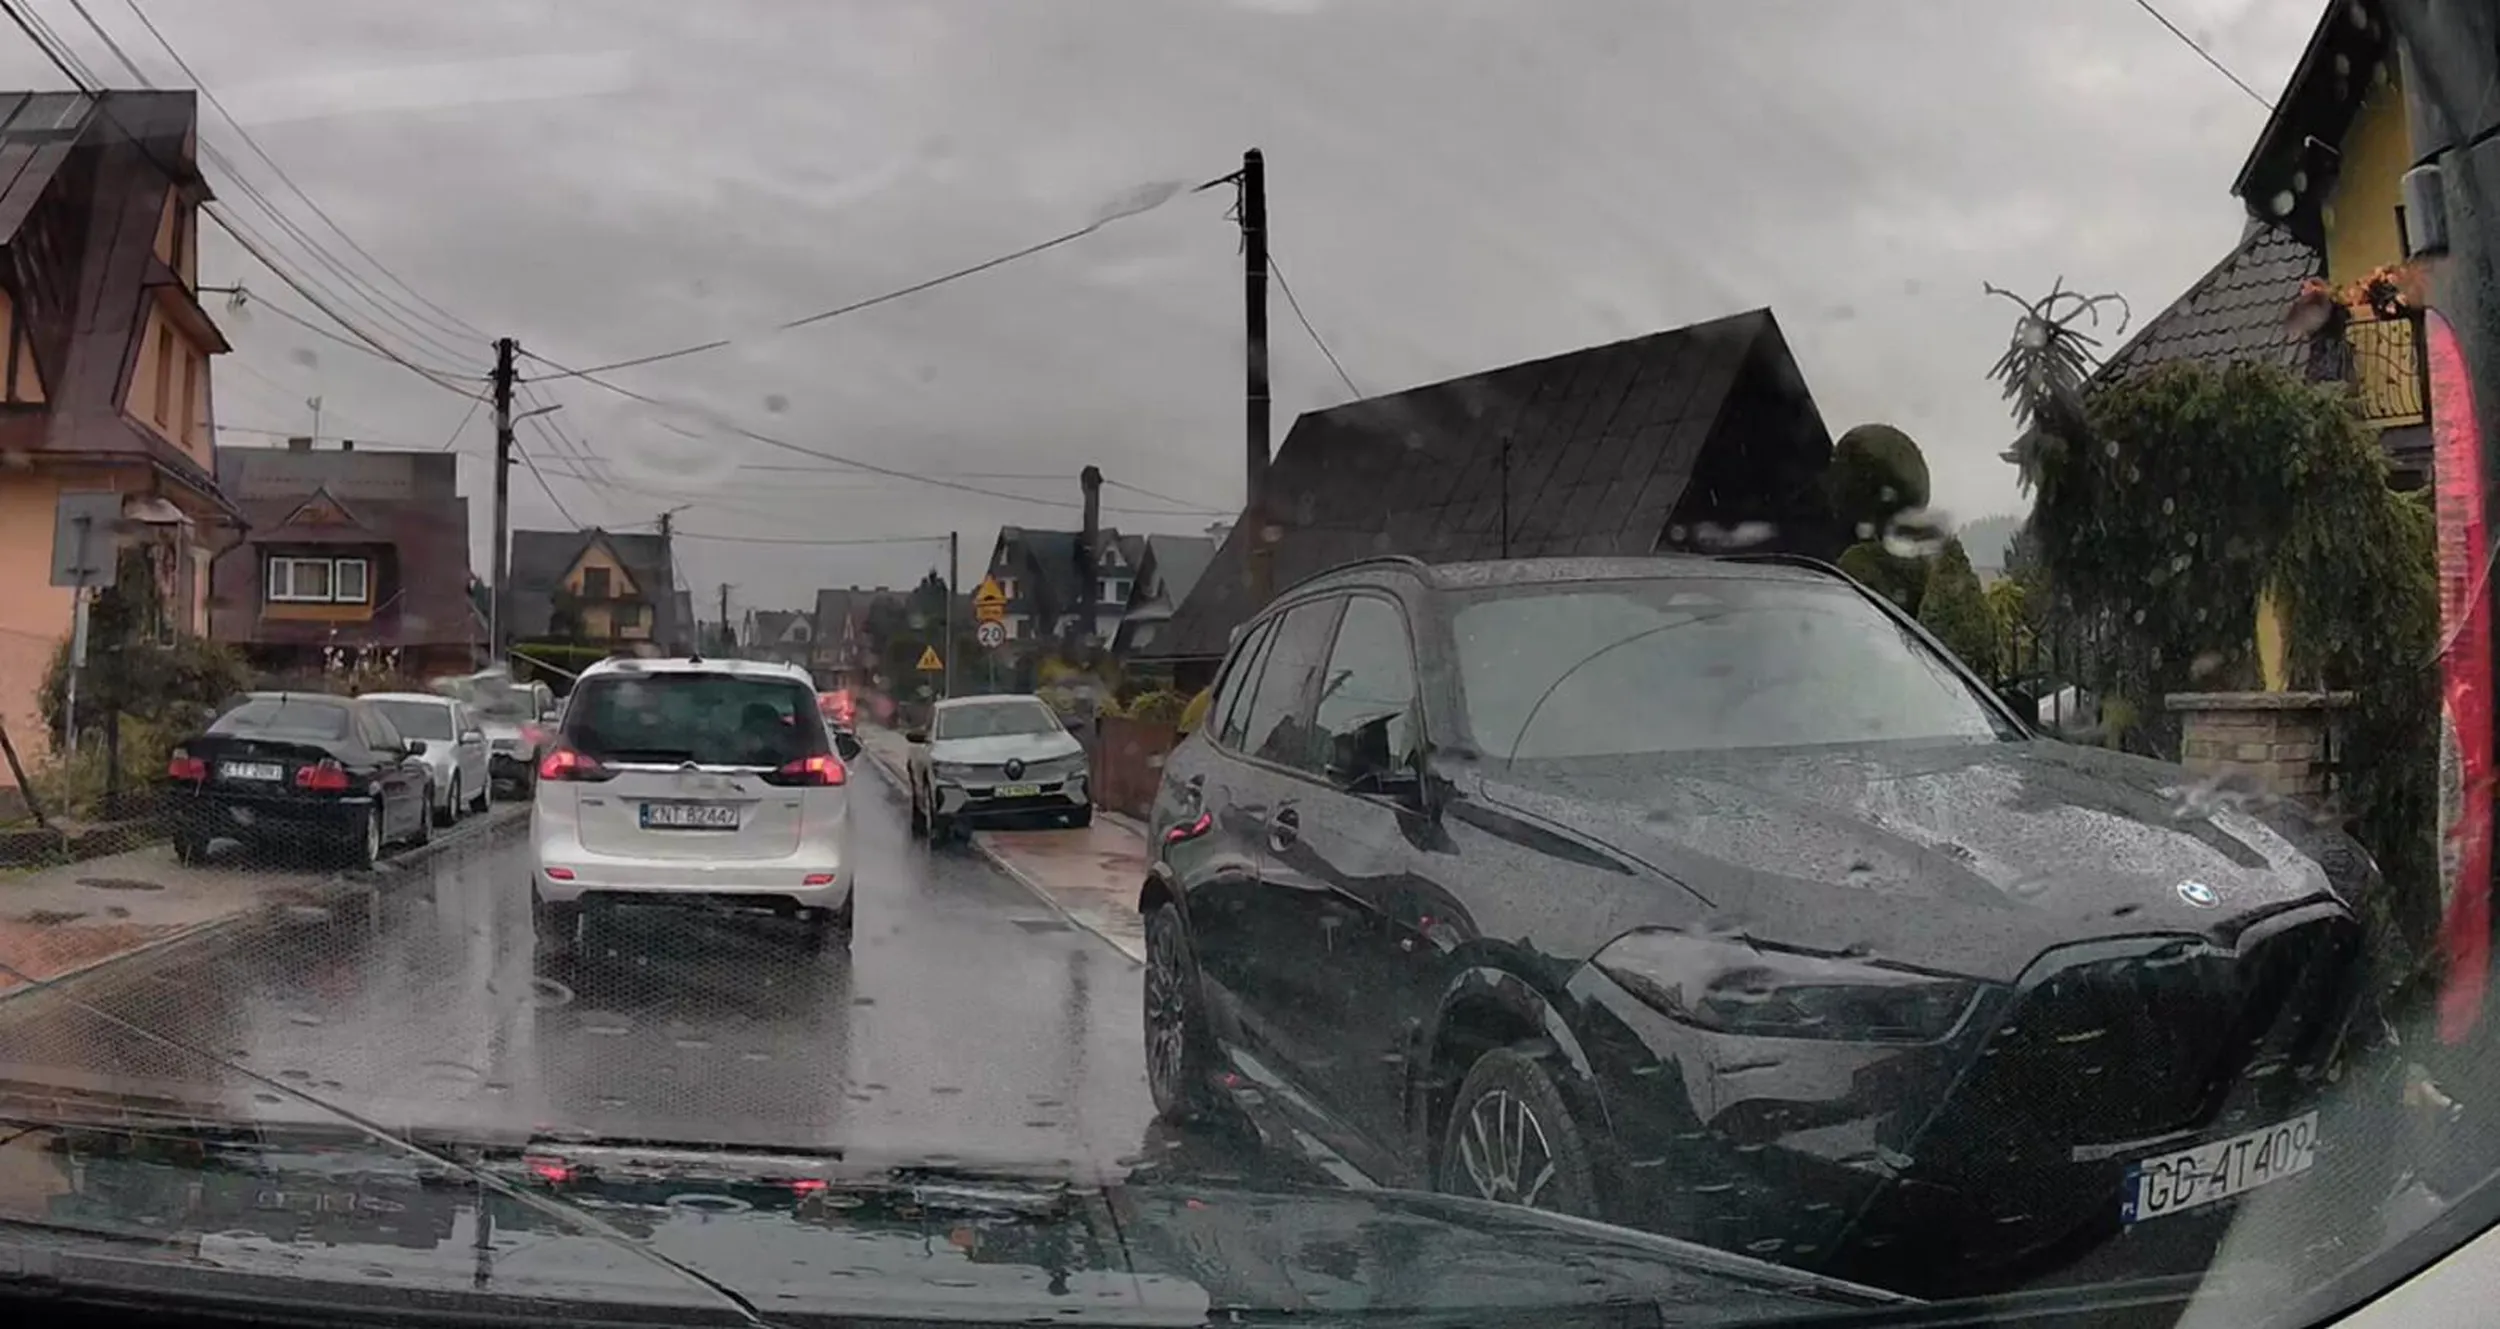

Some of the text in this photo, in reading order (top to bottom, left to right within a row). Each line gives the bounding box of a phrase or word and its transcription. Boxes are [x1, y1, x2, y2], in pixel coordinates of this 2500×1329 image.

[981, 627, 1001, 642] 20
[652, 807, 682, 823] KNT
[2147, 1121, 2311, 1212] GD 4T409
